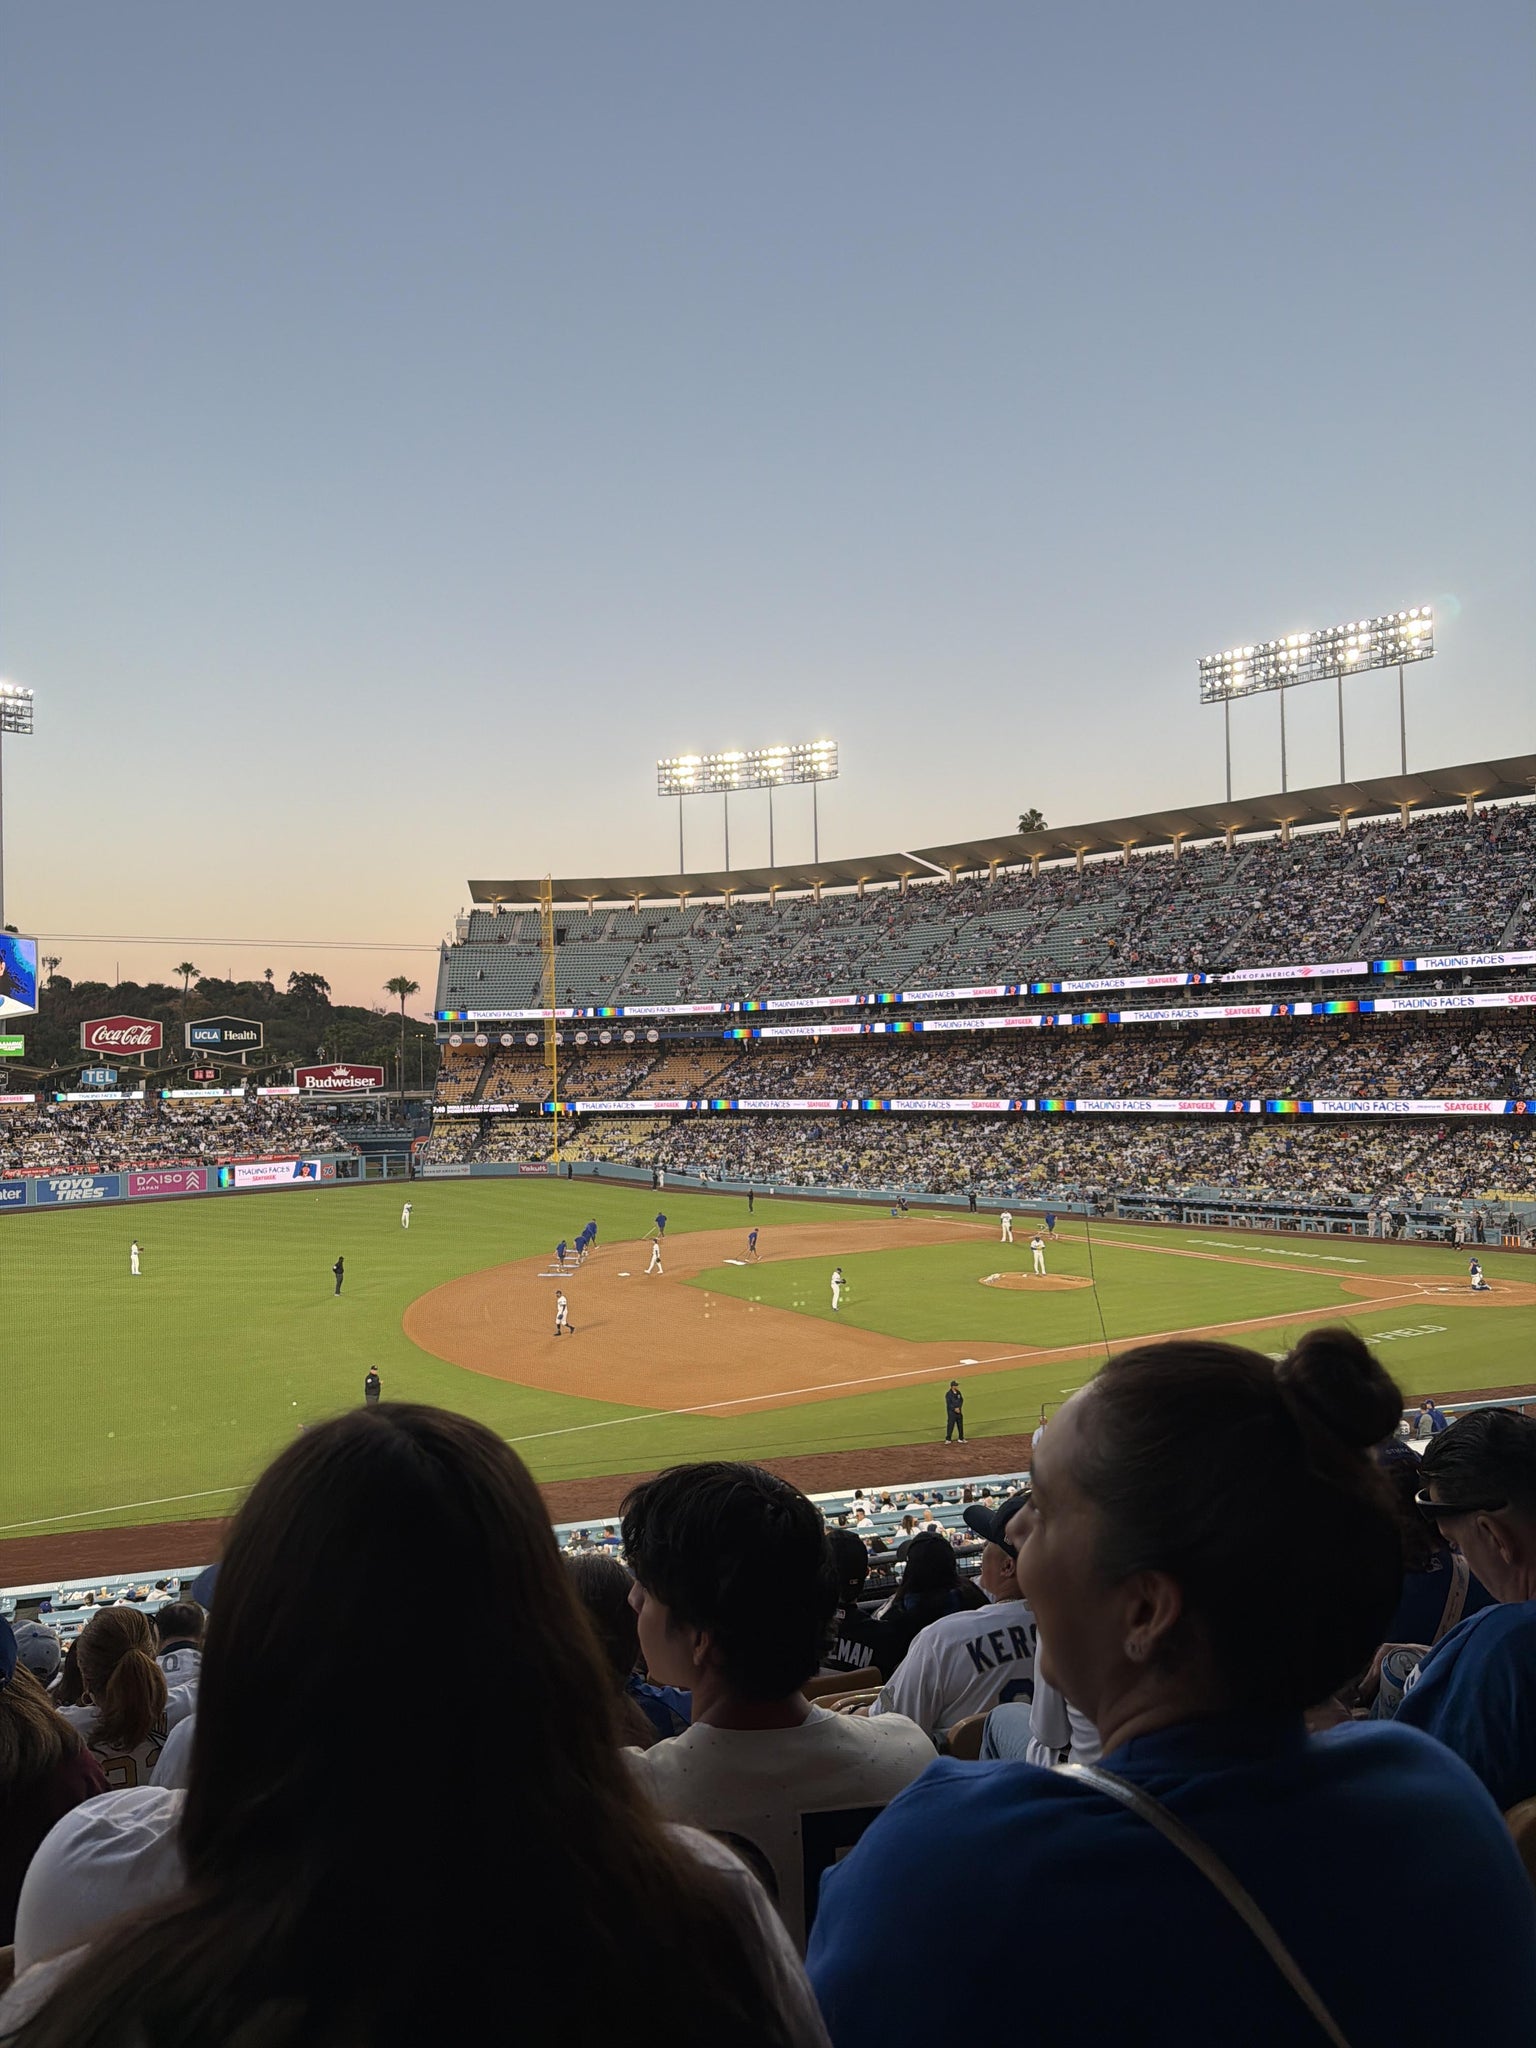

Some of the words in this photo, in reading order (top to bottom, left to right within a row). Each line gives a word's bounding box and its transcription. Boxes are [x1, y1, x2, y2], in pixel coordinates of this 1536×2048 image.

[1424, 958, 1468, 968] TRADING
[1470, 955, 1505, 965] FACES
[1147, 976, 1178, 984] SEATGEEK
[1392, 999, 1438, 1008] TRADING
[1440, 996, 1475, 1006] FACES
[1508, 994, 1536, 1004] SEATG
[1134, 1012, 1169, 1020] TRADING
[1171, 1010, 1199, 1018] FACES
[1224, 1007, 1262, 1016] SEATGEEK
[92, 1025, 155, 1046] Coca-Cola
[194, 1031, 219, 1040] UCLA
[224, 1030, 257, 1040] Health
[86, 1070, 114, 1082] TEL
[1083, 1102, 1120, 1110] TRADING
[1122, 1102, 1152, 1110] FACES
[1178, 1102, 1216, 1110] SEATGEEK
[1322, 1102, 1370, 1111] TRADING
[1372, 1102, 1410, 1111] FACES
[1444, 1102, 1492, 1112] SEATGEEK
[520, 1164, 547, 1172] Yakult
[49, 1178, 94, 1191] TOYO
[137, 1174, 182, 1186] DAISO
[56, 1187, 105, 1200] TIRES
[1372, 1324, 1448, 1340] FIELD
